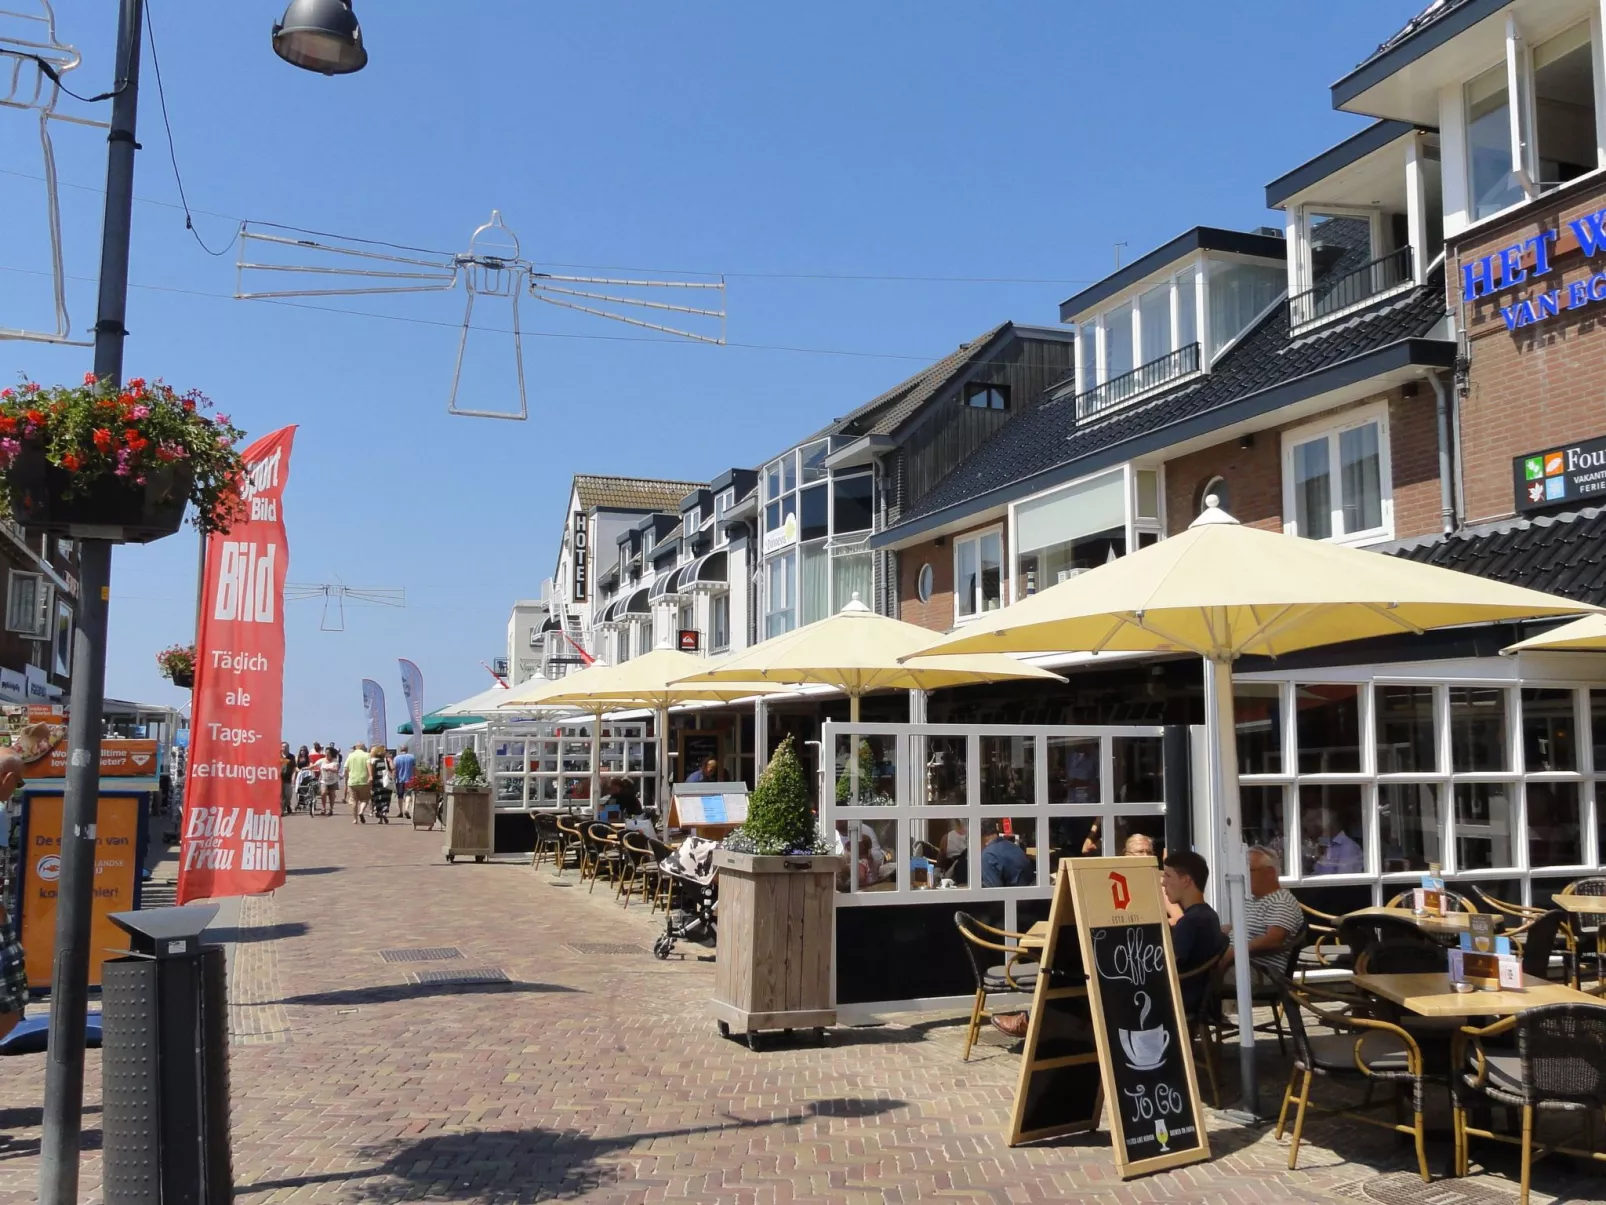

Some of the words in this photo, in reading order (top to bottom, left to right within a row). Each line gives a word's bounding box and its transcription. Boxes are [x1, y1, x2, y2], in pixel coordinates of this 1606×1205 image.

[1461, 228, 1558, 302] HET
[1499, 289, 1560, 331] VAN
[1566, 447, 1606, 472] Fou
[251, 497, 277, 522] Bild
[576, 515, 586, 598] HOTEL
[214, 541, 276, 623] Bild
[208, 723, 262, 746] Tages-
[185, 806, 240, 838] Bild
[240, 808, 280, 842] Auto
[35, 835, 53, 846] De
[106, 836, 129, 846] van
[184, 839, 235, 871] Frau
[241, 842, 280, 871] Bild
[204, 836, 223, 848] der
[94, 859, 124, 867] LANDSE
[1092, 927, 1164, 986] Coffee
